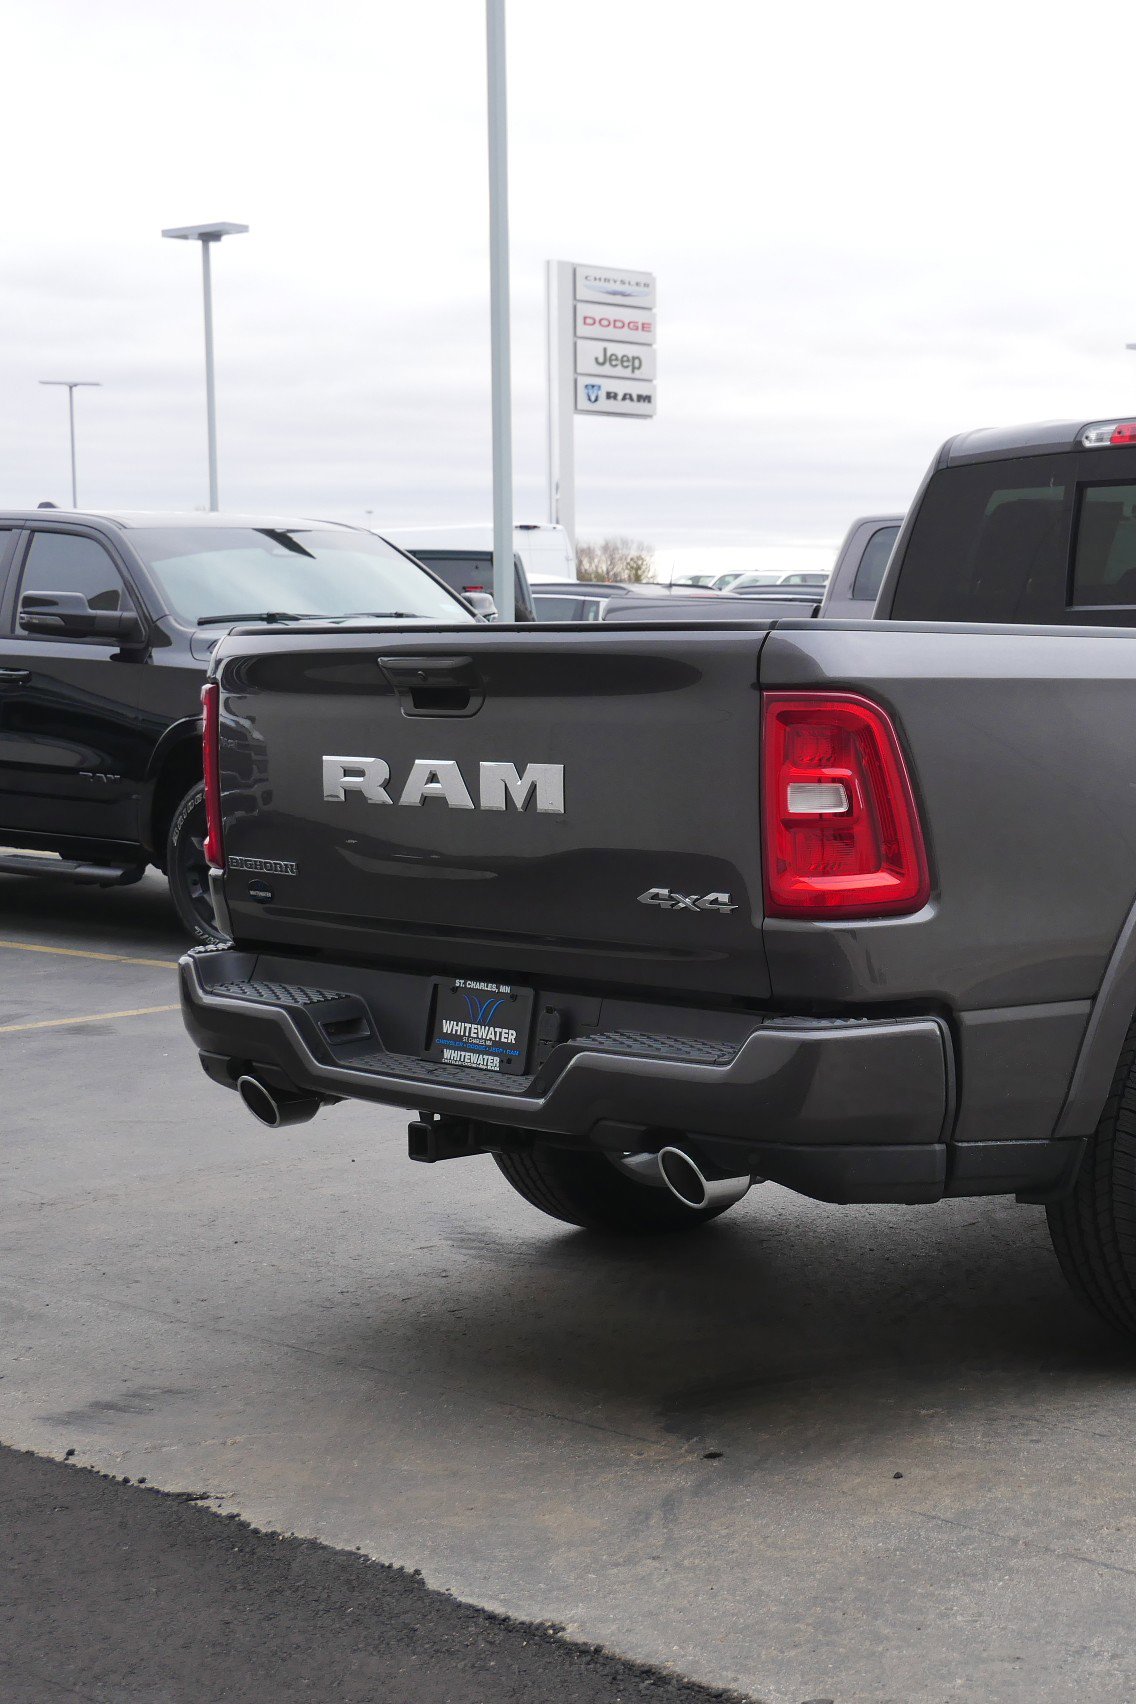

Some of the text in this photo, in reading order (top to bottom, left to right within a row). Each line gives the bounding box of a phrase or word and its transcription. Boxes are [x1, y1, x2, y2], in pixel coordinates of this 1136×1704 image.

[584, 275, 651, 288] CHRYSLER
[583, 316, 652, 333] DODGE
[594, 347, 642, 374] Jeep
[605, 391, 652, 404] RAM
[322, 755, 566, 814] RAM
[455, 979, 510, 993] ST. CHARLES, MN
[443, 1020, 516, 1043] WHITEWATER
[444, 1048, 500, 1066] WHITEWATER
